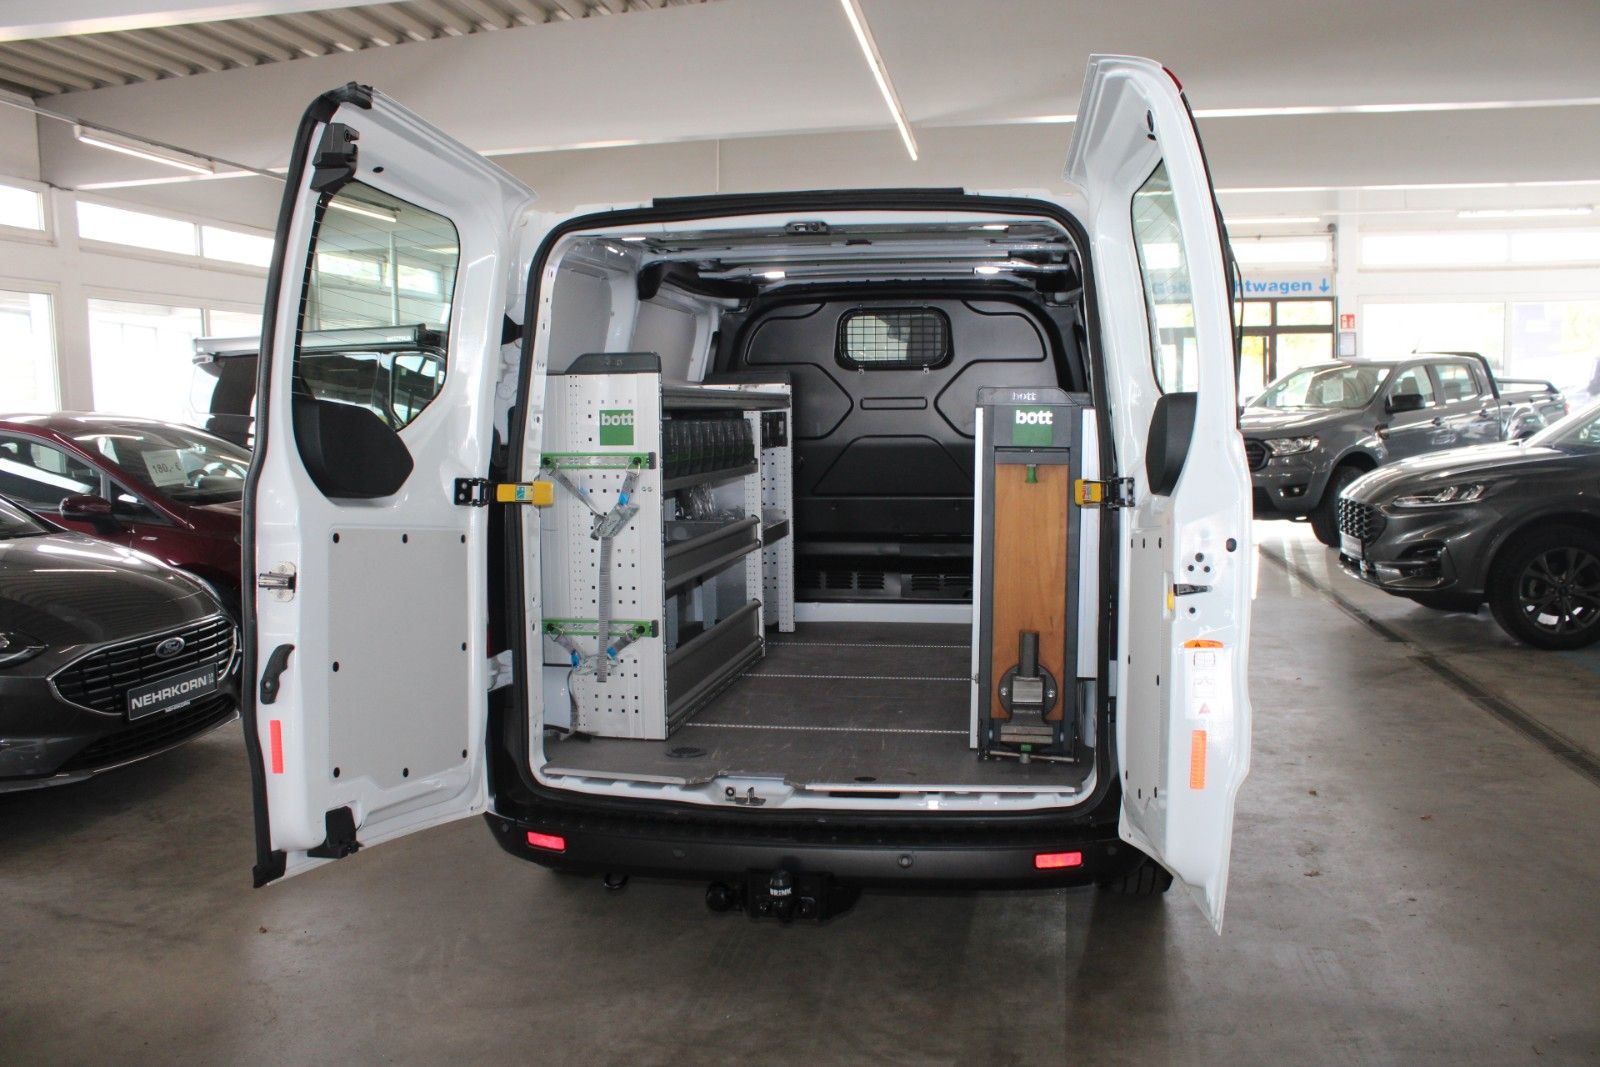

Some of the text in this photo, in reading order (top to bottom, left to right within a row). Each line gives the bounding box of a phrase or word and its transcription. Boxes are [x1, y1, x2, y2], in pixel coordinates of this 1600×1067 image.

[601, 413, 634, 426] bott
[1015, 410, 1053, 425] bott
[131, 676, 207, 710] NEHRKORN
